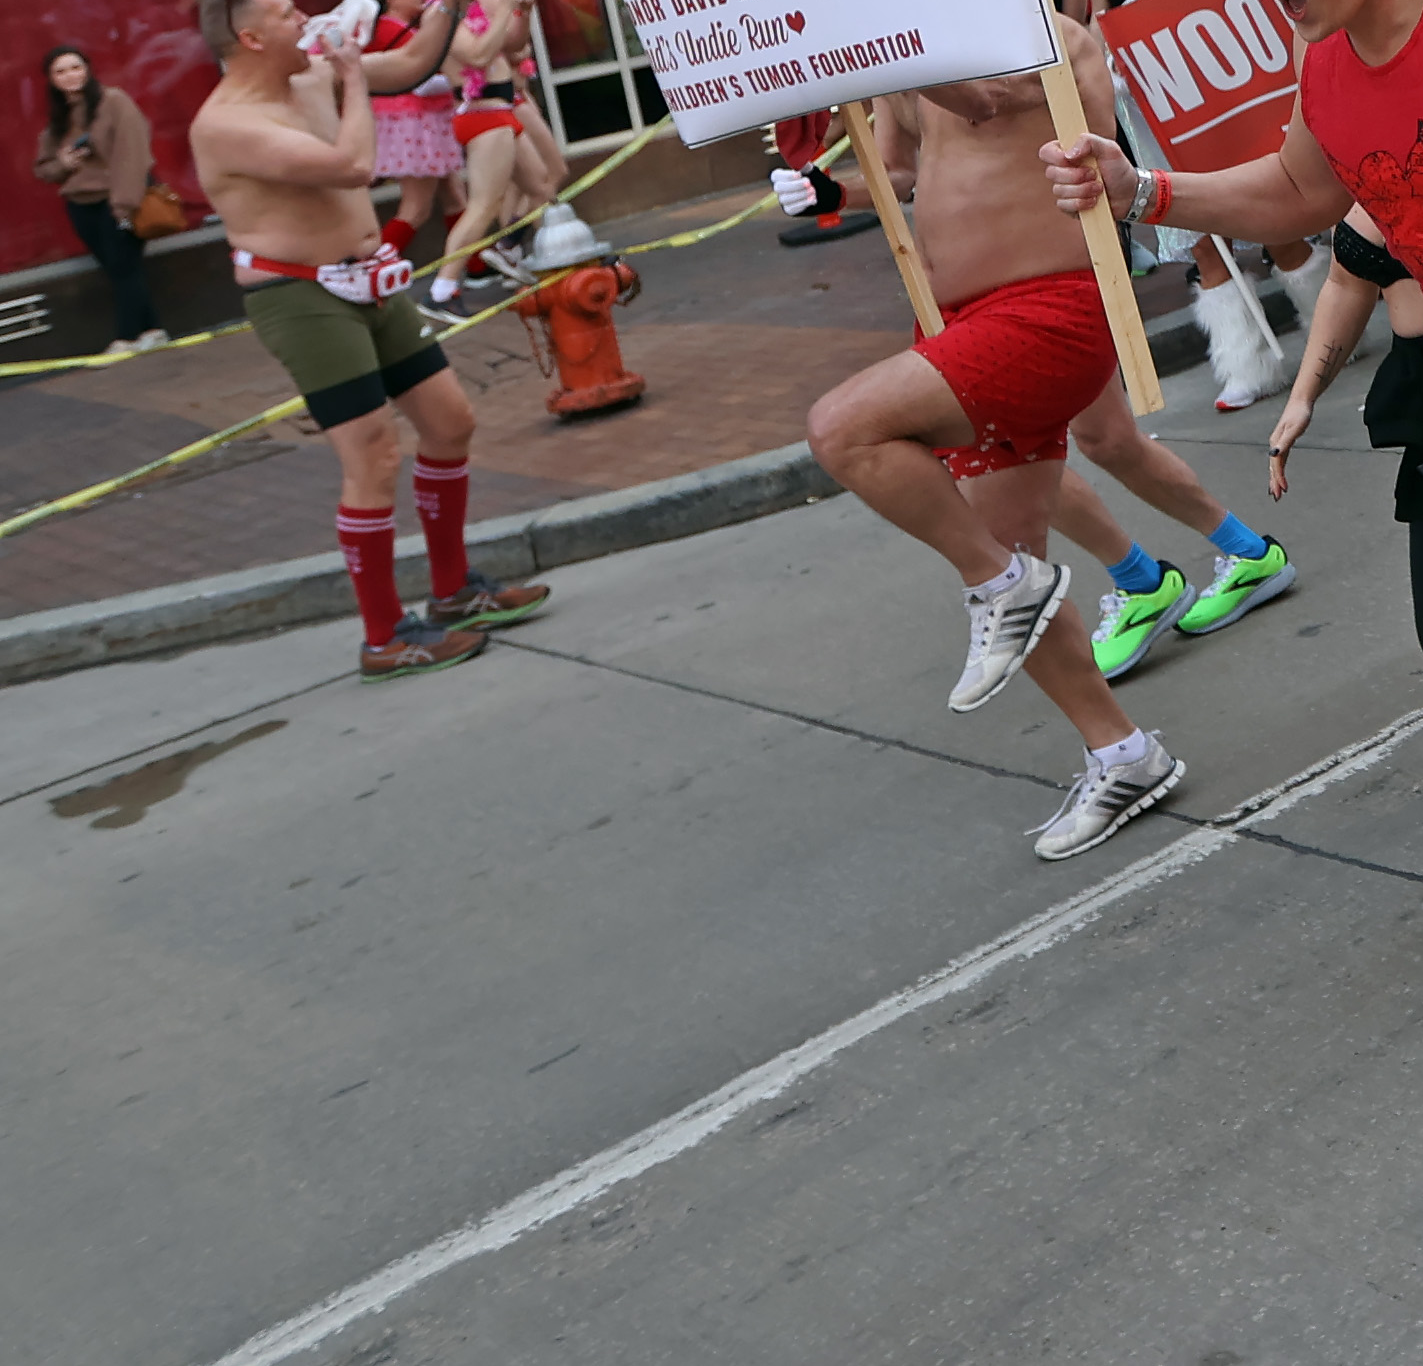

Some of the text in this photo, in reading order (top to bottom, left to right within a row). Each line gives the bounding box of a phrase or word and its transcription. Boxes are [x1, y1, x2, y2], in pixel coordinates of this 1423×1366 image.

[675, 16, 742, 68] Undie
[739, 12, 789, 53] Run
[744, 58, 809, 95] TUMOR
[808, 27, 926, 81] FOUNDATION
